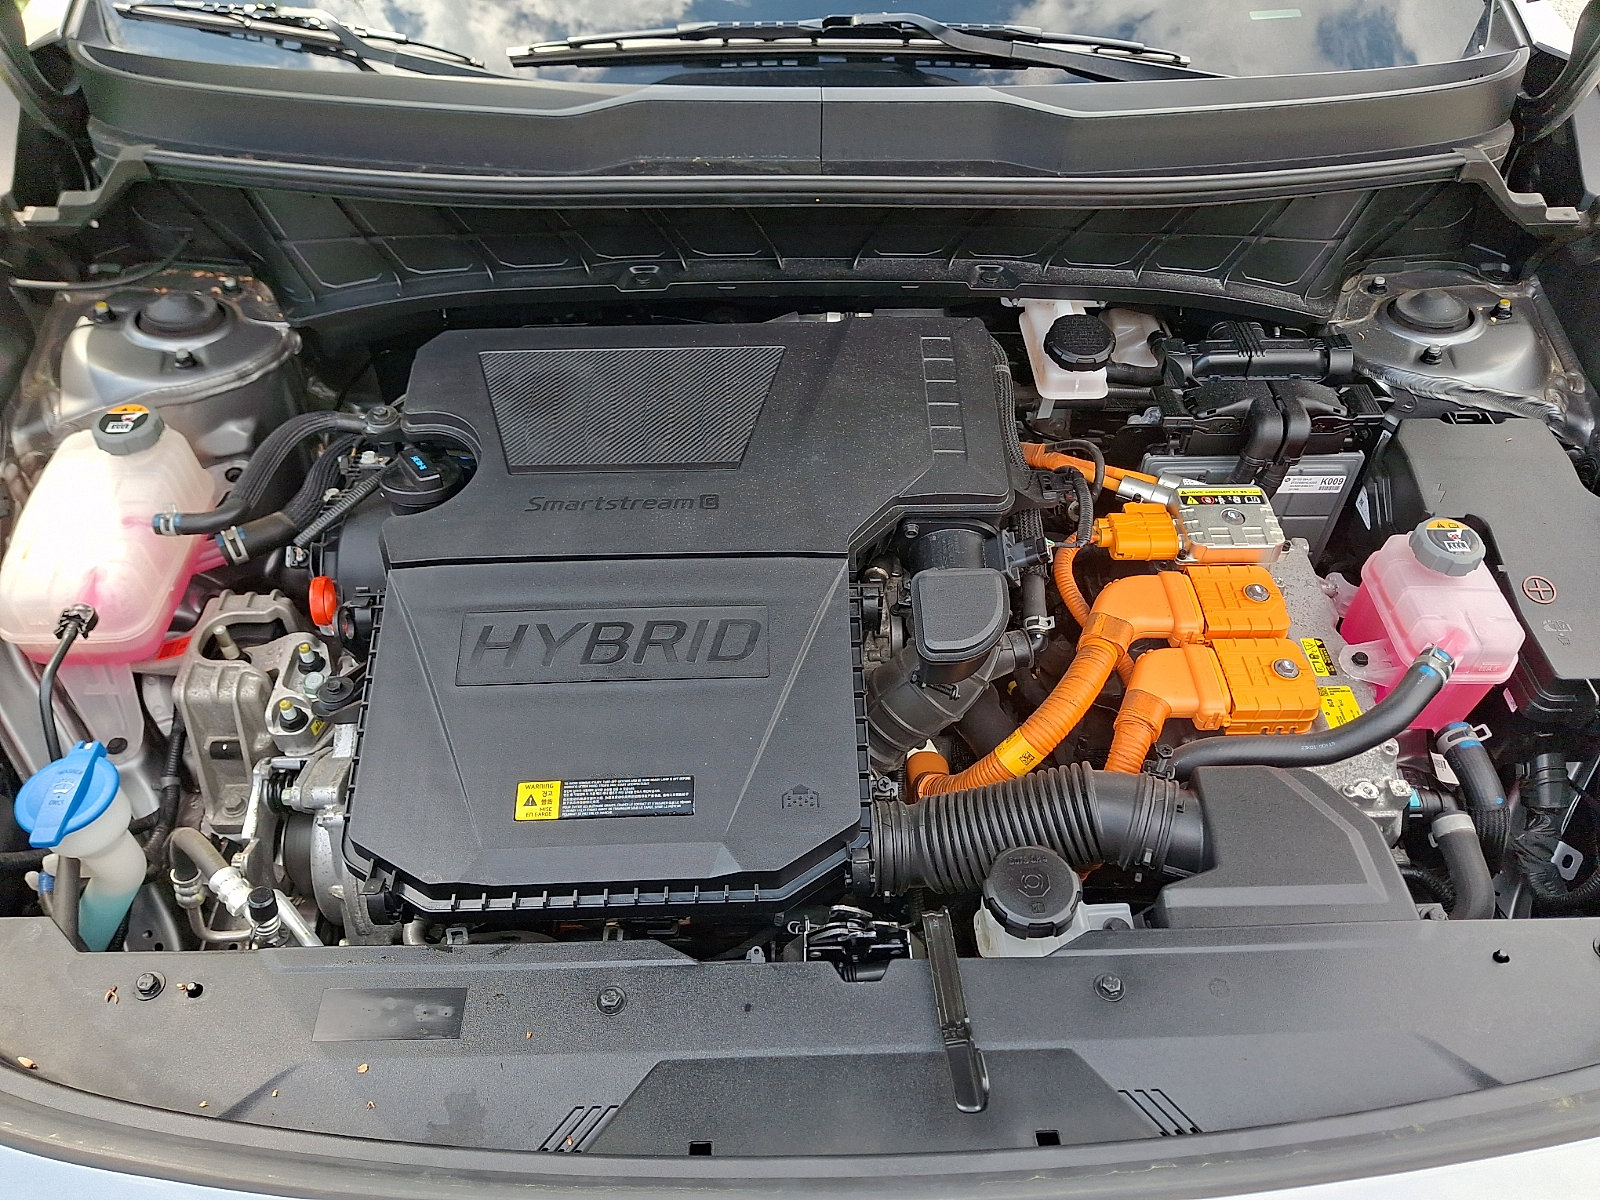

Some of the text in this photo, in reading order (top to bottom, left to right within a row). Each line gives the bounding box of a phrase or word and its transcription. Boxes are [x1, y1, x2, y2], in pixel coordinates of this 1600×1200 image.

[1319, 477, 1345, 486] K009
[524, 496, 695, 512] Smartstream
[470, 618, 762, 669] HYBRID
